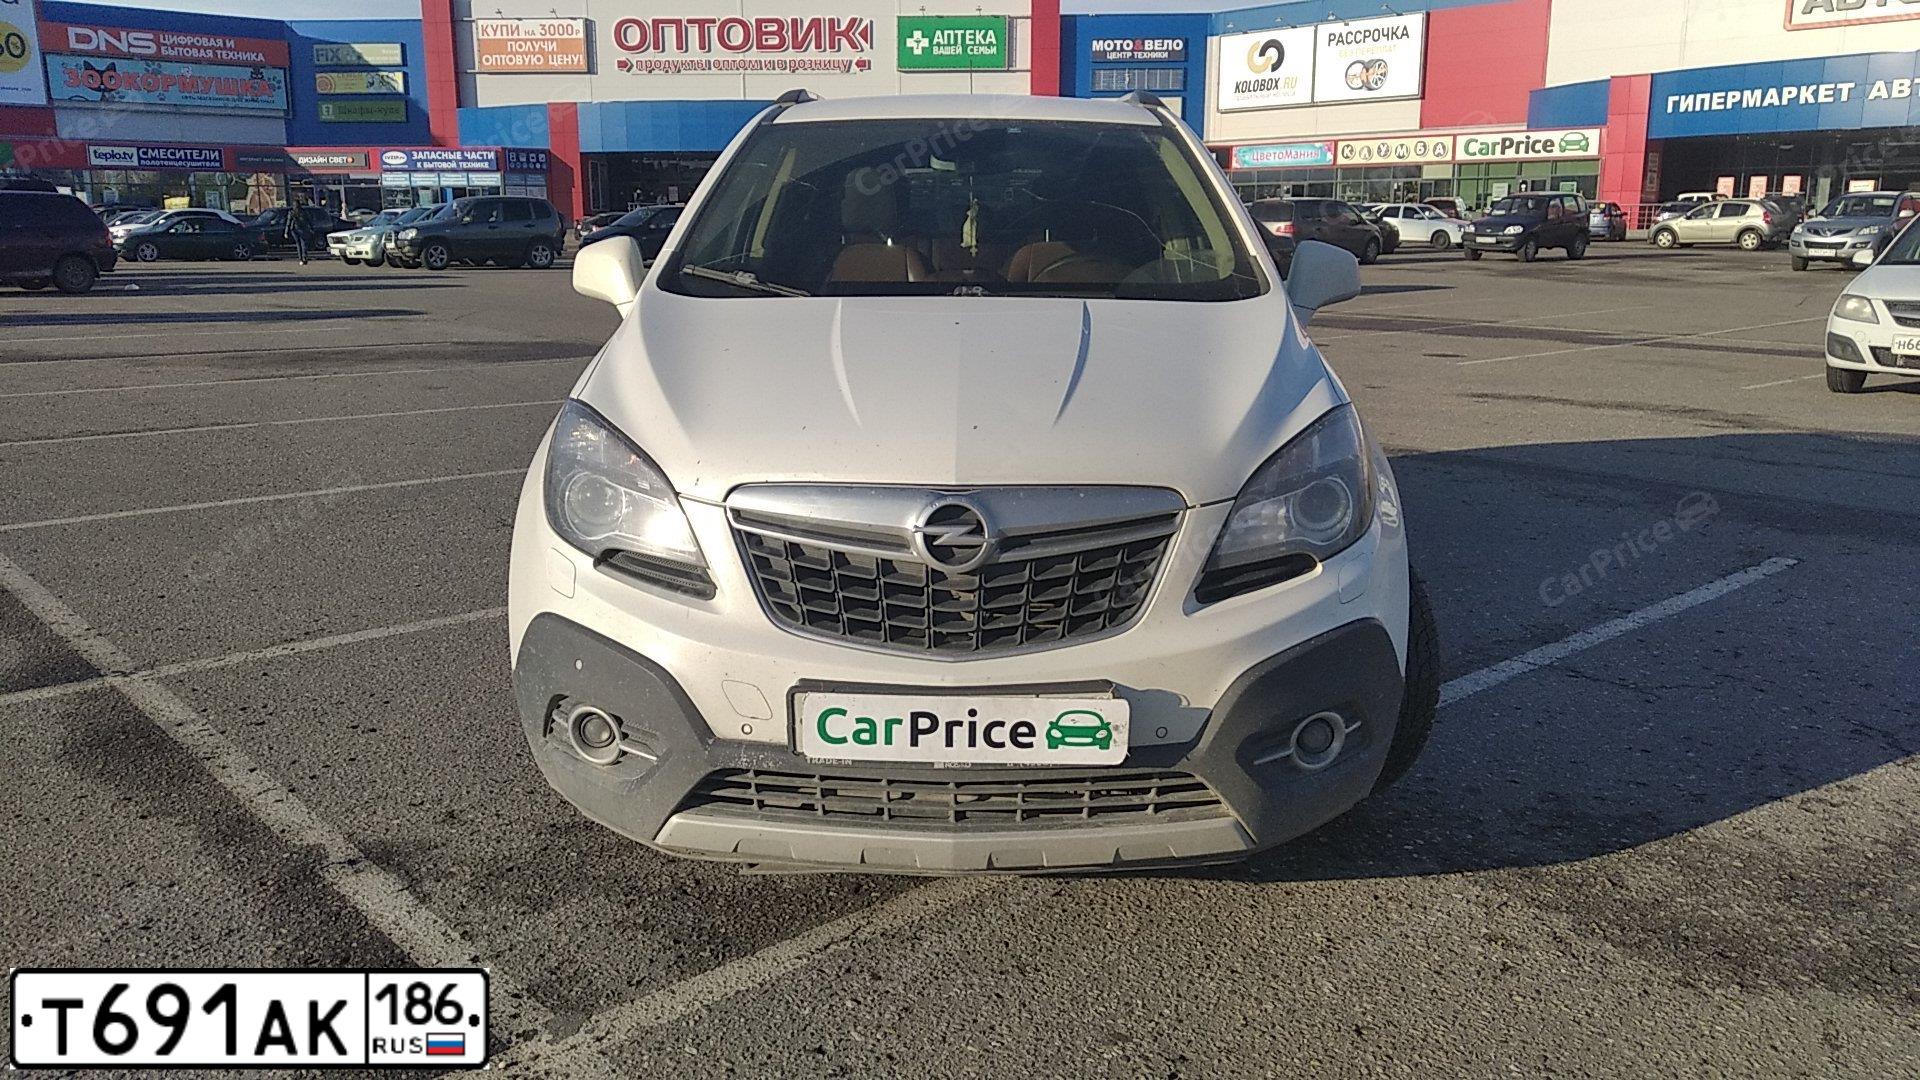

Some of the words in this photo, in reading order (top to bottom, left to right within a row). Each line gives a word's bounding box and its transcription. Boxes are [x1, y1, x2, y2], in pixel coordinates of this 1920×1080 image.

[481, 24, 520, 37] КУПИ
[613, 17, 861, 52] ОПТОВИК
[1327, 25, 1410, 47] РАССРОЧКА
[0, 32, 25, 58] 0
[67, 27, 157, 54] DNS
[159, 34, 223, 48] ЦИФРОВАЯ
[226, 40, 235, 49] И
[933, 30, 997, 46] АПТЕКА
[507, 41, 557, 52] ПОЛУЧИ
[933, 46, 963, 55] ВАШЕЙ
[967, 46, 997, 55] СЕМЬИ
[161, 47, 213, 59] БЫТОВАЯ
[215, 50, 265, 62] ТЕХНИКА
[482, 55, 543, 66] ОПТОВУЮ
[548, 55, 583, 67] ЦЕНУ!
[1107, 51, 1132, 60] ЦЕНТР
[1134, 51, 1168, 59] ТЕХНИКИ
[636, 59, 710, 73] продукты
[712, 60, 763, 71] оптом
[788, 60, 850, 73] розницу
[63, 68, 275, 98] ЗООКОРМУШКА
[1666, 82, 1856, 114] ГИПЕРМАРКЕТ
[1464, 135, 1555, 157] CarPrice
[93, 149, 134, 163] teplo.tv
[139, 148, 220, 160] СМЕСИТЕЛИ
[298, 156, 326, 165] ДИЗАЙН
[412, 151, 462, 160] ЗАПАСНЫЕ
[464, 151, 495, 160] ЧАСТИ
[416, 161, 422, 169] К
[423, 160, 457, 169] БЫТОВОЙ
[459, 161, 489, 169] ТЕХНИКЕ
[817, 708, 1037, 749] CarPrice
[805, 757, 853, 766] TRADE-IN
